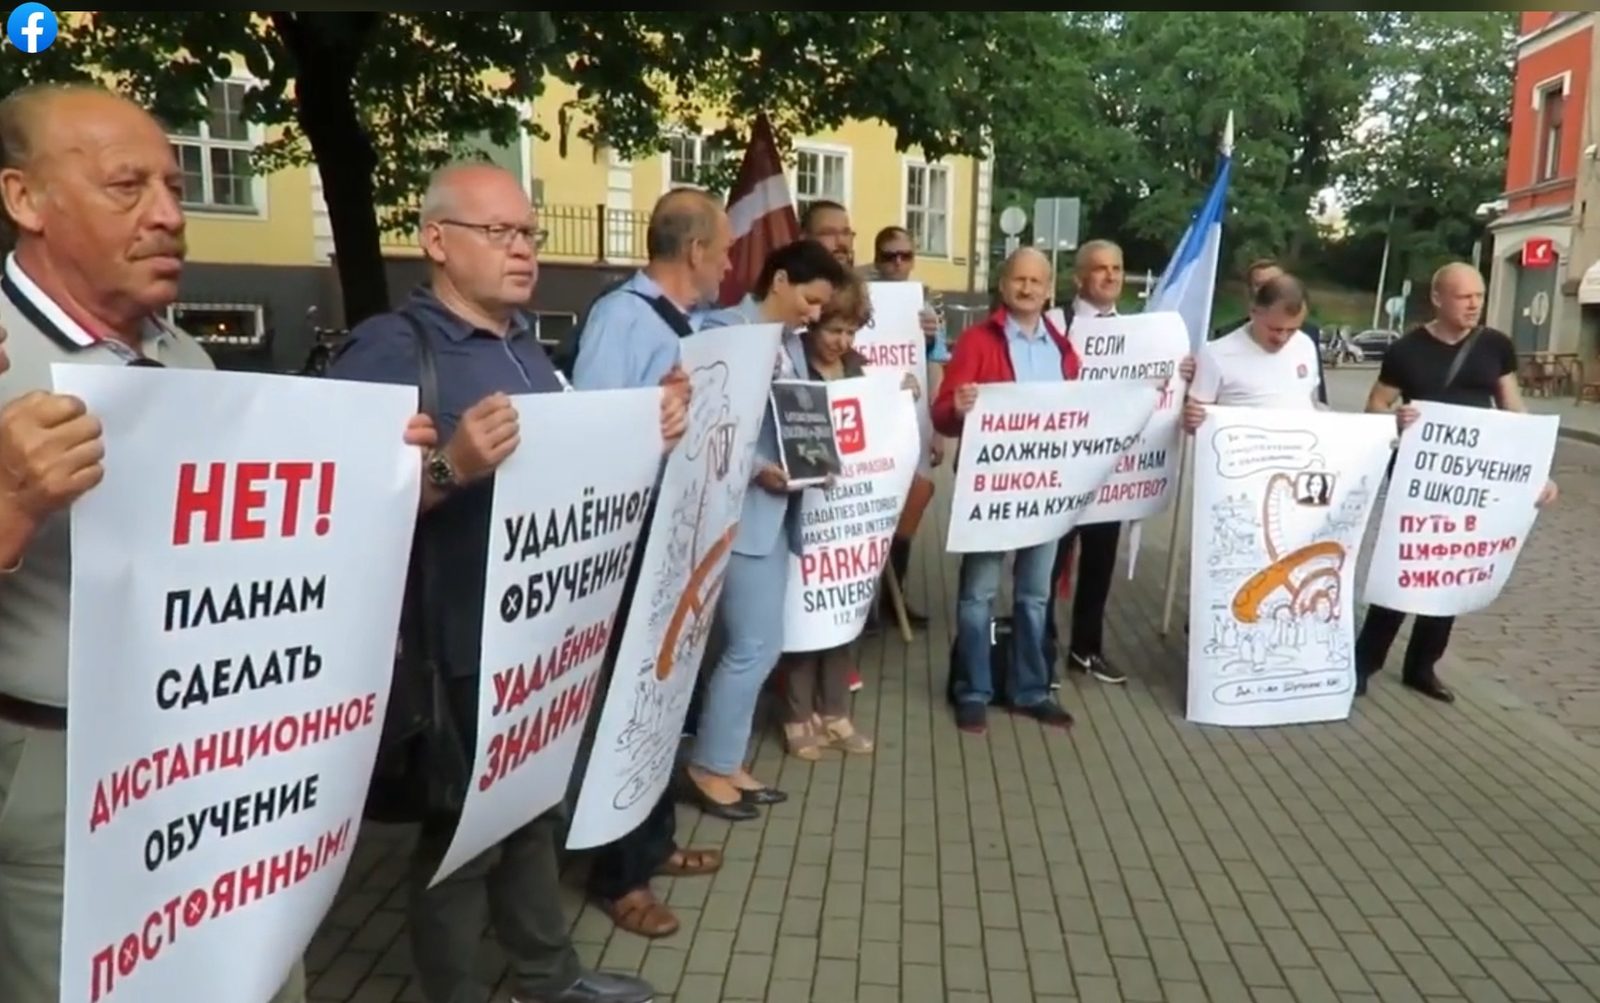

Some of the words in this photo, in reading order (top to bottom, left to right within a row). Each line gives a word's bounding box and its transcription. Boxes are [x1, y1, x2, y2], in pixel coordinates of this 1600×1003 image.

[1084, 335, 1126, 356] ЕСЛИ
[981, 412, 1039, 432] НАШИ
[1043, 411, 1090, 432] ДЕТИ
[1421, 422, 1480, 448] ОТКАЗ
[976, 440, 1068, 465] ДОЛЖНЫ
[1137, 449, 1166, 471] НАМ
[1415, 451, 1439, 471] ОТ
[1441, 454, 1532, 483] ОБУЧЕНИЯ
[973, 474, 985, 492] В
[1098, 478, 1167, 504] ДАРСТВО?
[1408, 479, 1421, 498] В
[1424, 482, 1490, 508] ШКОЛЕ
[171, 461, 336, 546] НЕТ!
[801, 505, 856, 527] EGĀDĀTIES
[969, 503, 982, 521] А
[988, 502, 1010, 520] НЕ
[1015, 500, 1040, 518] НА
[844, 521, 863, 539] PAR
[1400, 514, 1456, 533] ПУТЬ
[1465, 515, 1477, 532] В
[800, 536, 890, 587] PĀRKĀP
[1399, 536, 1517, 560] ЦИФРОВУЮ
[500, 541, 632, 623] ОБУЧЕНИЕ
[803, 576, 877, 613] SATVERS
[163, 575, 327, 632] ПЛАНАМ
[156, 644, 322, 711] СДЕЛАТЬ
[492, 611, 616, 717] УДАЛЁННЫ
[89, 693, 377, 833] ДИСТАНЦИОННОЕ
[144, 774, 319, 872] ОБУЧЕНИЕ
[90, 817, 353, 1003] ПОСТОЯННЫМ!
